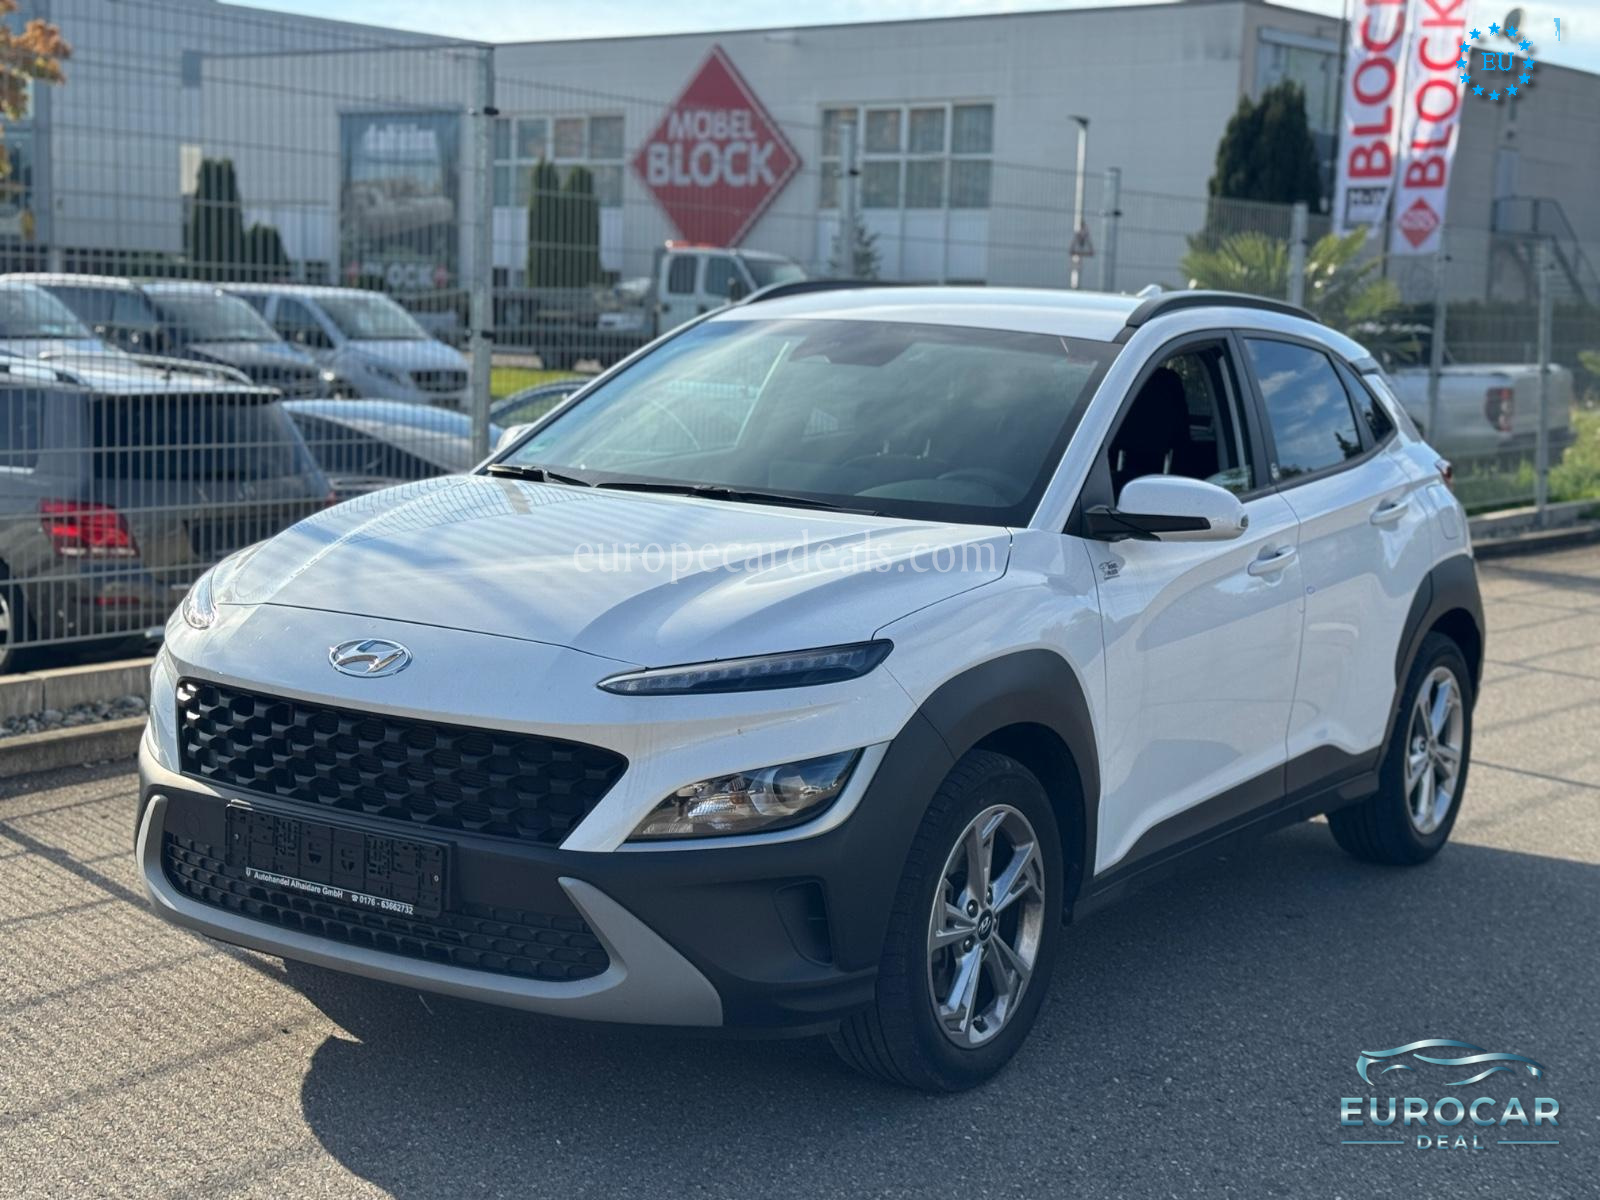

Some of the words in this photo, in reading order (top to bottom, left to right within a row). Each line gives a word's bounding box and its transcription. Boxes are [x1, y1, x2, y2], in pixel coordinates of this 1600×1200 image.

[1348, 0, 1405, 179] BLOC
[1403, 0, 1466, 189] BLOCK
[647, 141, 776, 188] BLOCK
[254, 872, 290, 886] Autohandel
[322, 887, 344, 899] GmbH
[359, 895, 376, 906] 0176
